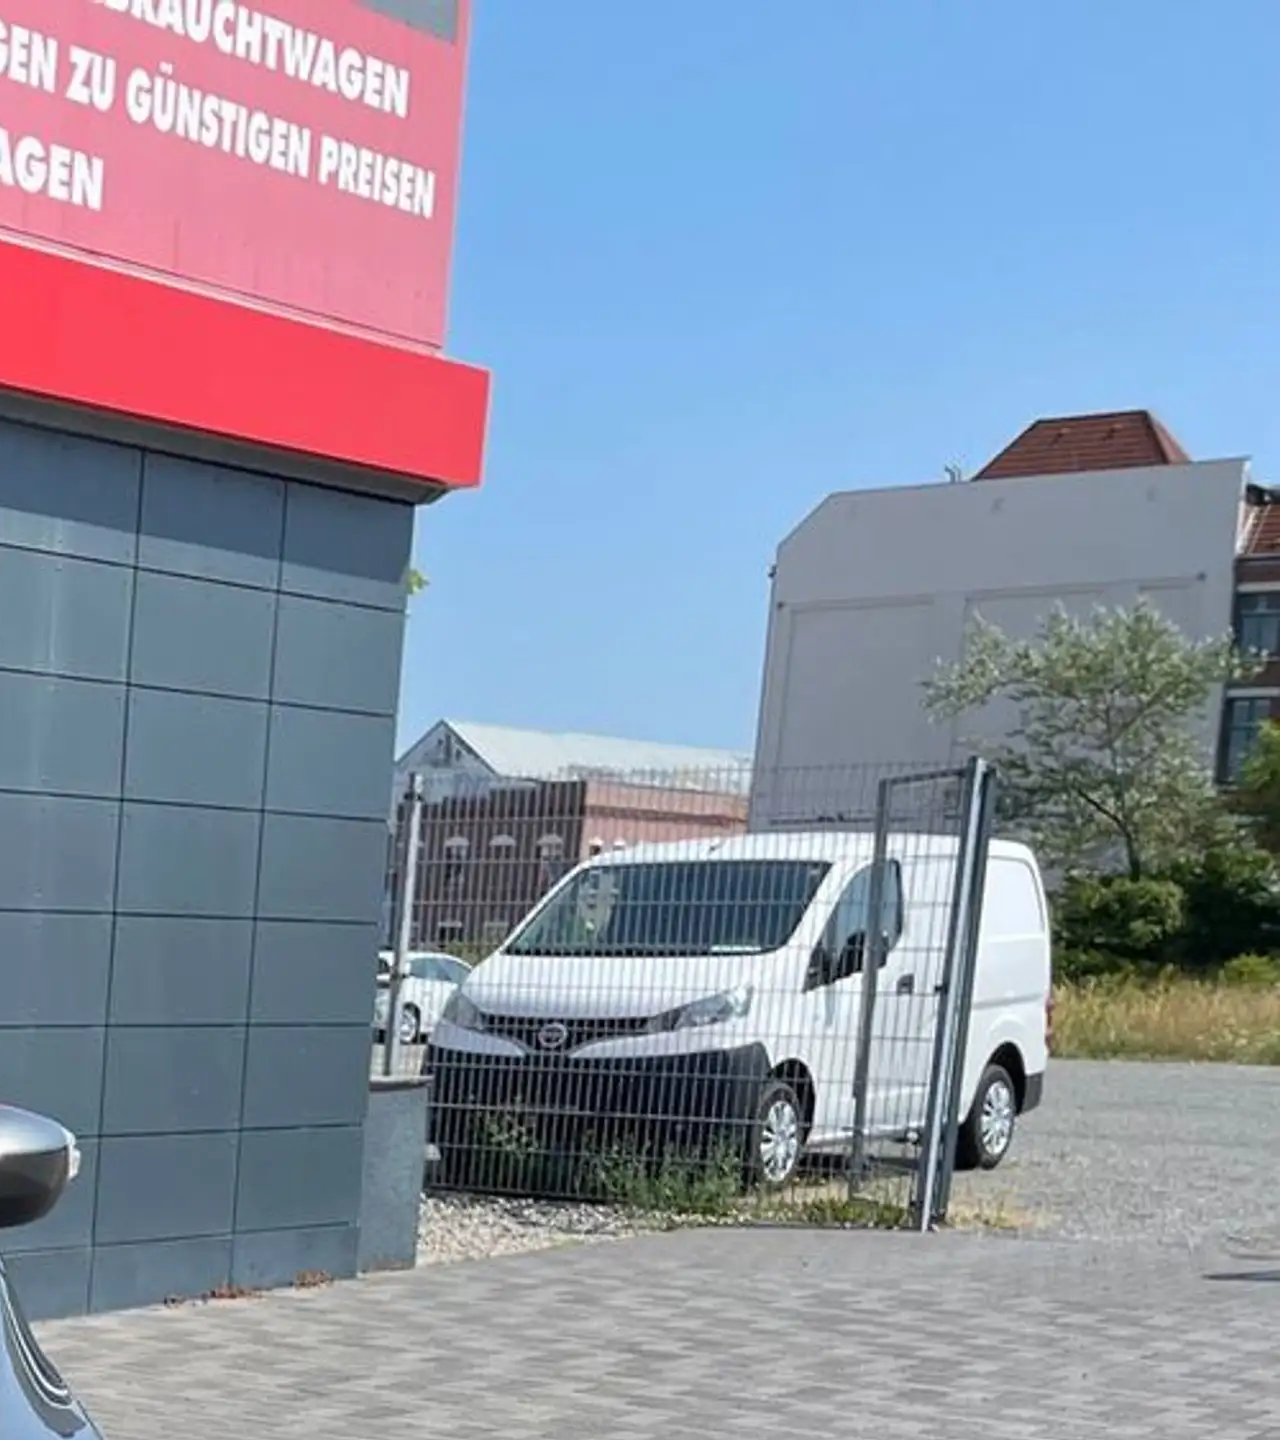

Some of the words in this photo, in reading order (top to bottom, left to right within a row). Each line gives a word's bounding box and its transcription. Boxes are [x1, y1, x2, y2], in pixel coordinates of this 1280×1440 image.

[66, 45, 117, 112] ZU
[126, 62, 311, 179] GÜNSTIGEN
[319, 135, 436, 219] PREISEN
[90, 0, 410, 118] AUCHTWAGEN
